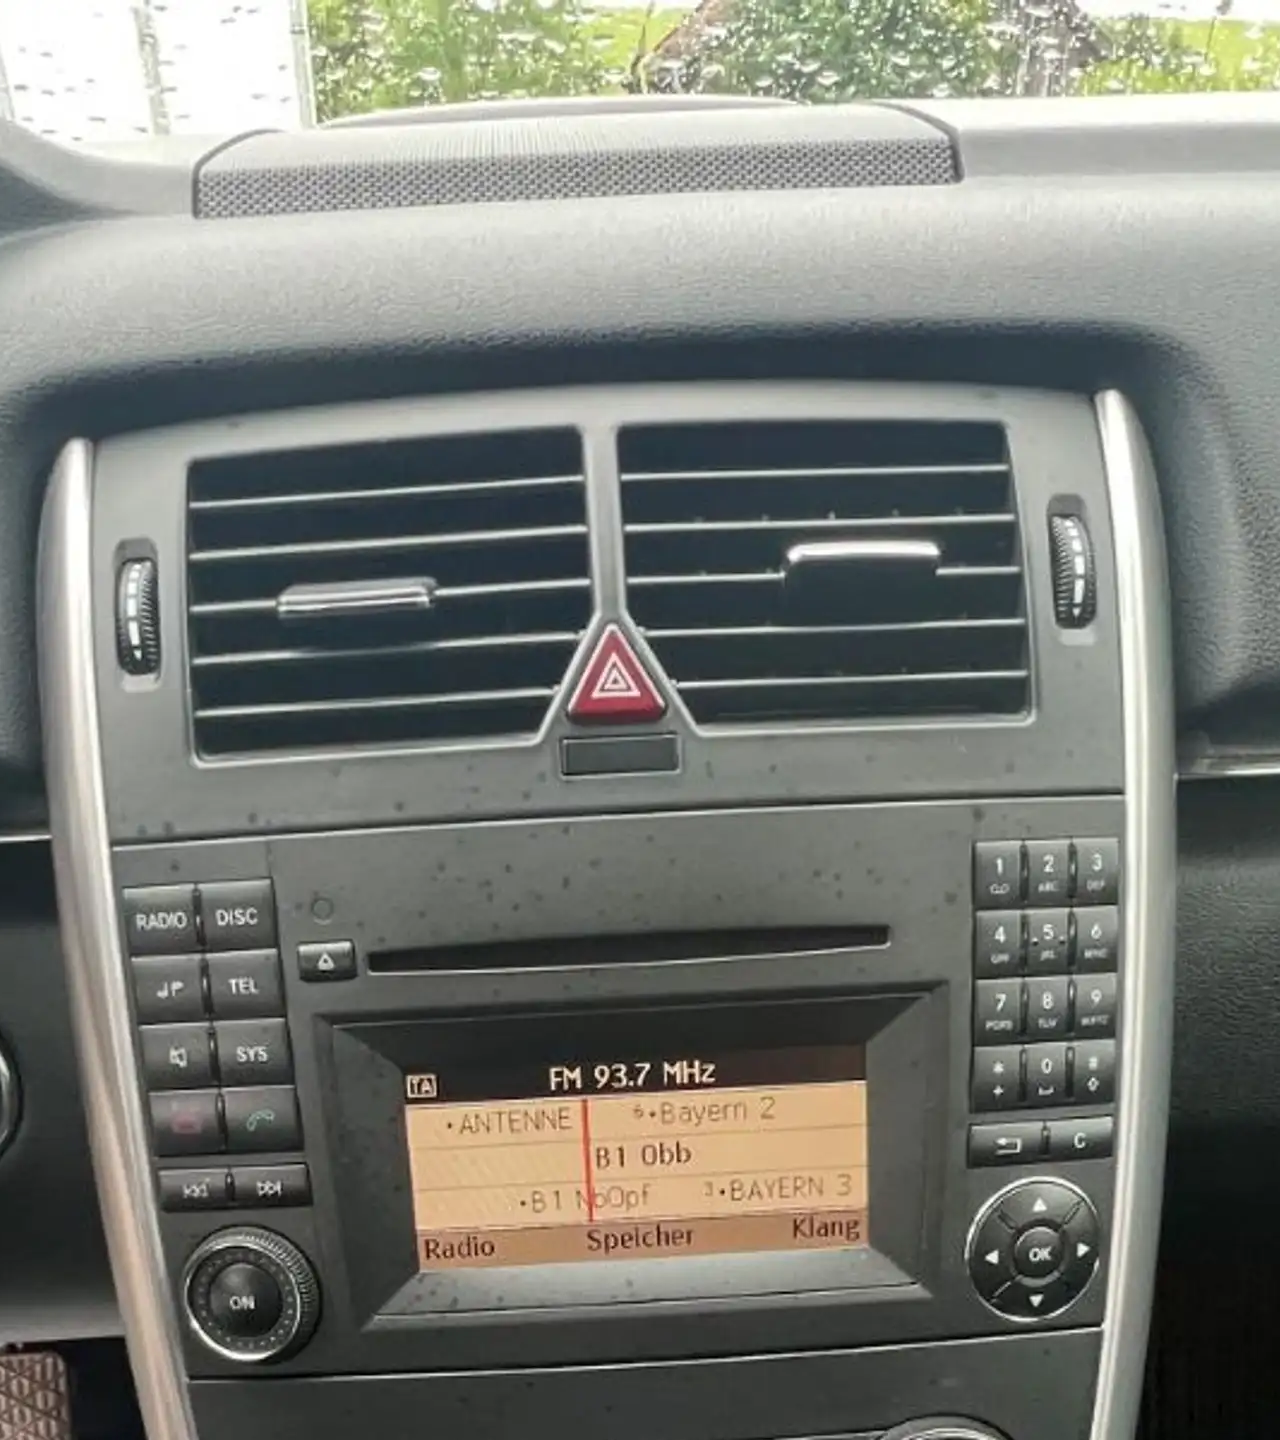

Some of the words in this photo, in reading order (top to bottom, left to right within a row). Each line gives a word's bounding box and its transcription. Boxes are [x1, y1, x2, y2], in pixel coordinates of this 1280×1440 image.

[995, 857, 1004, 875] 1
[1043, 854, 1055, 873] 2
[1091, 853, 1103, 872] 3
[135, 911, 188, 931] RADIO
[215, 906, 258, 927] DISC
[994, 926, 1006, 943] 4
[1042, 924, 1055, 940] 5
[1091, 924, 1102, 940] 6
[228, 976, 259, 995] TEL
[995, 993, 1007, 1011] 7
[1042, 991, 1053, 1010] 8
[1091, 989, 1102, 1007] 9
[236, 1045, 268, 1063] SYS
[549, 1065, 582, 1091] FM
[594, 1062, 651, 1089] 93.7
[663, 1060, 716, 1085] MHz
[1041, 1058, 1052, 1074] 0
[459, 1107, 573, 1135] ANTENNE
[661, 1101, 747, 1127] Bayern
[760, 1096, 776, 1120] 2
[1074, 1132, 1086, 1149] C
[730, 1175, 824, 1202] BAYERN
[836, 1173, 853, 1196] 3
[792, 1216, 861, 1242] Klang
[424, 1236, 495, 1261] Radio
[587, 1224, 694, 1255] Speicher
[1028, 1246, 1052, 1262] OK
[229, 1296, 256, 1310] ON
